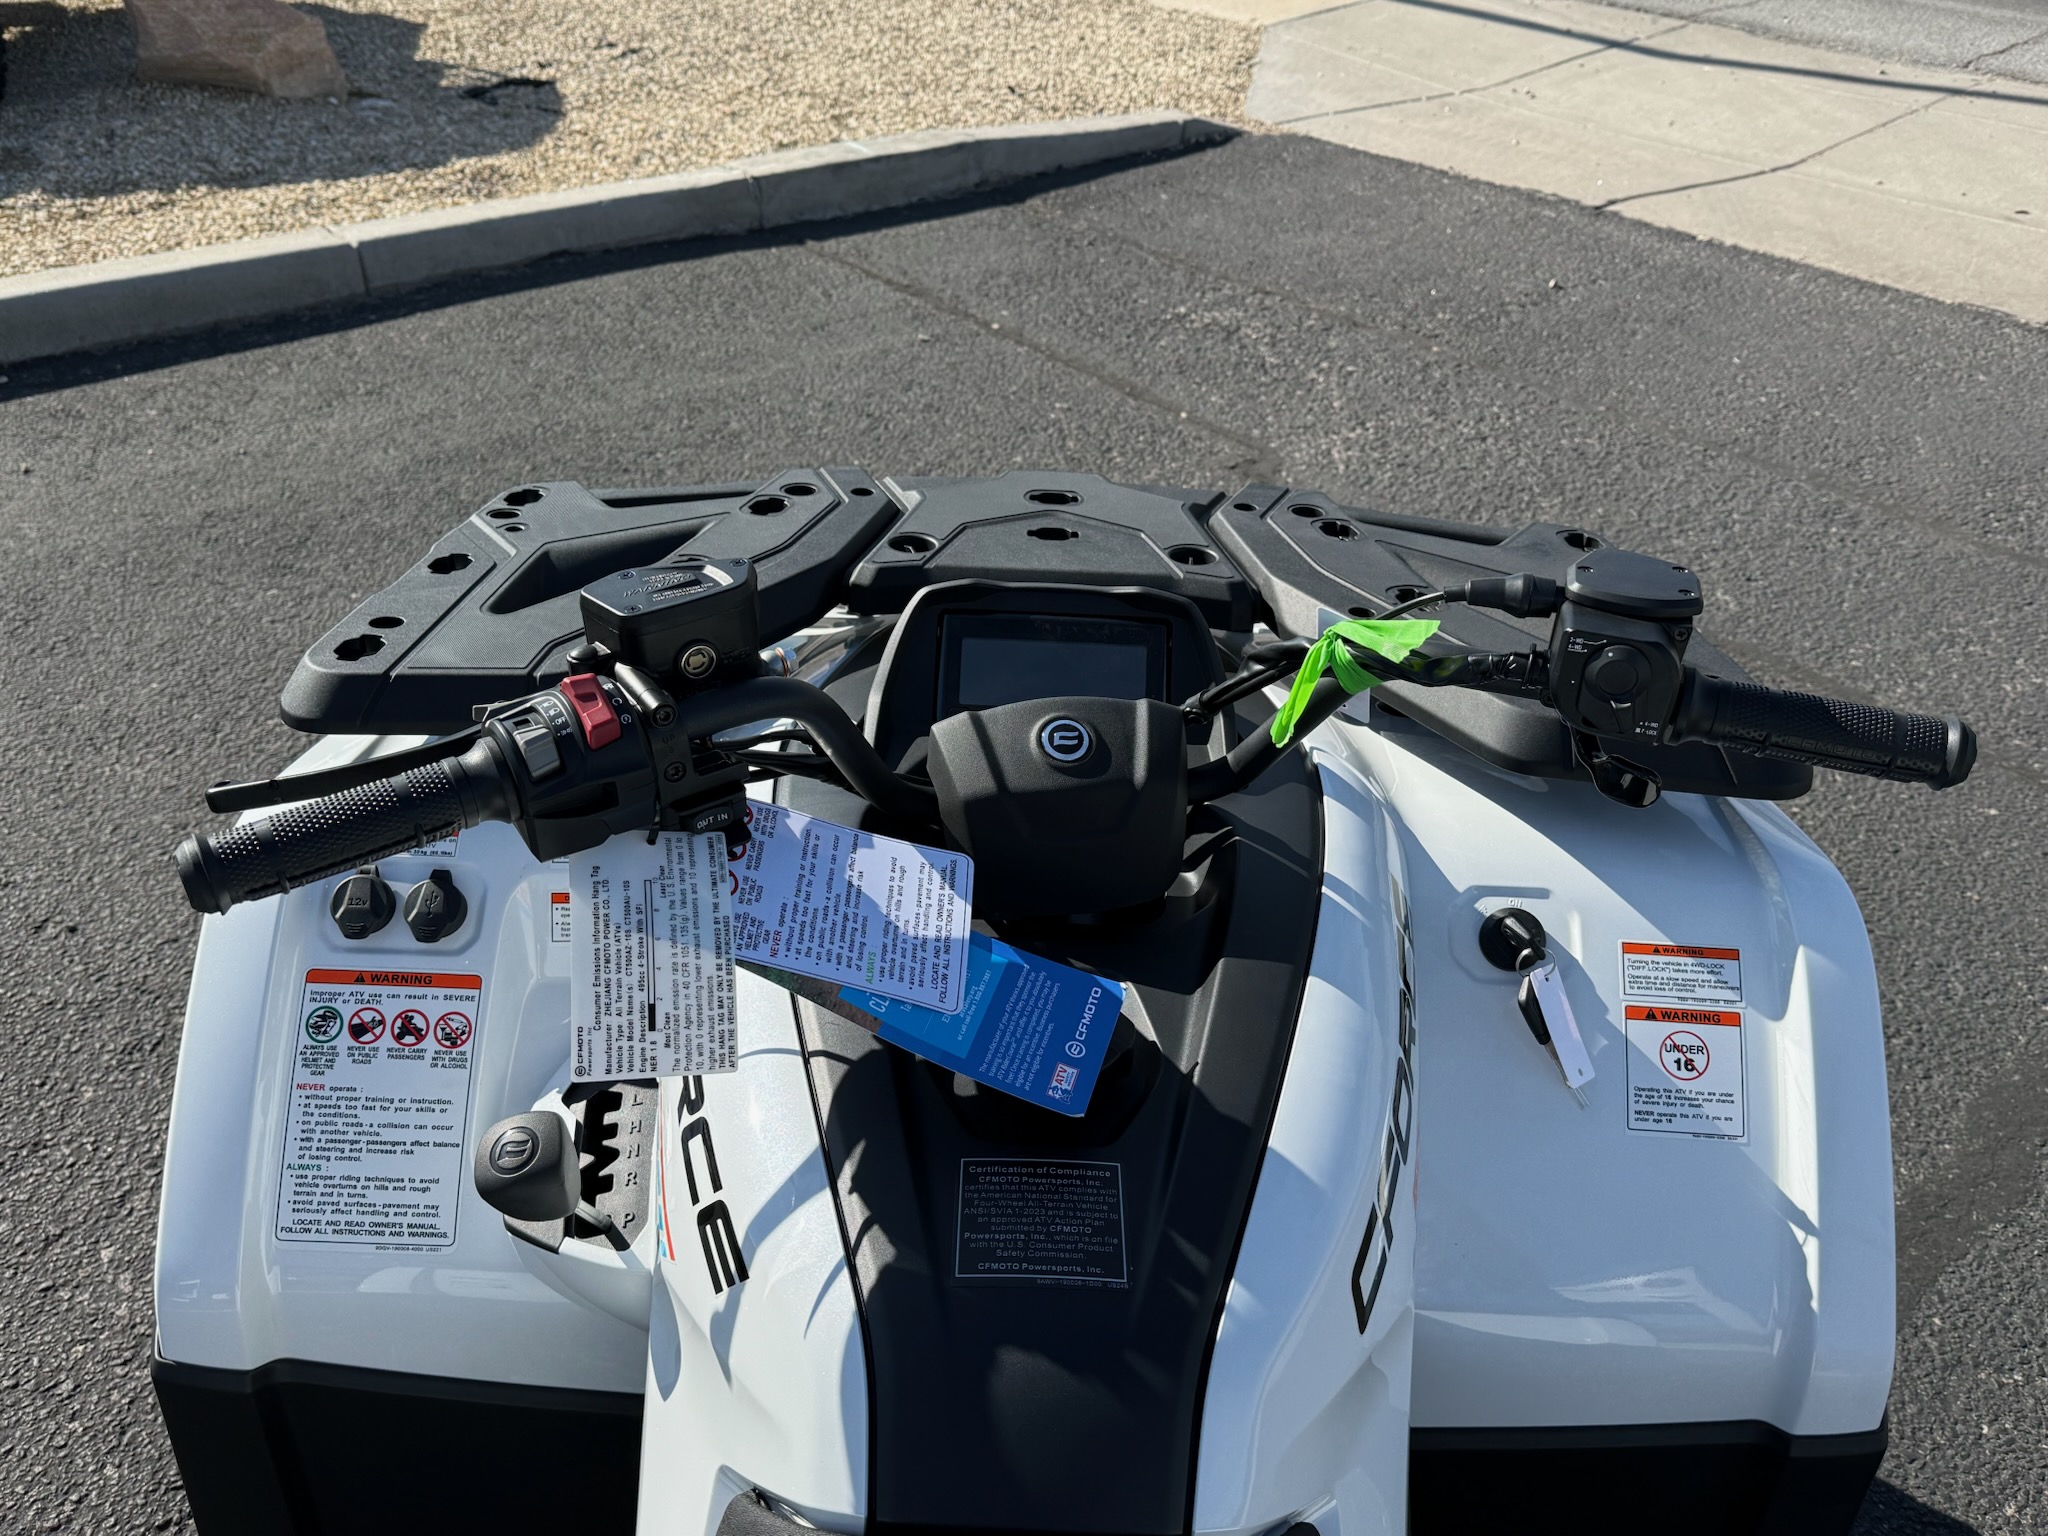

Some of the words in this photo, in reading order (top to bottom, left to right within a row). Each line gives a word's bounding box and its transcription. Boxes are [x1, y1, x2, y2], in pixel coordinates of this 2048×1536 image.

[555, 716, 566, 725] OFF
[696, 816, 714, 829] OUT
[717, 813, 728, 821] IN
[707, 836, 715, 867] CONSUMER
[591, 865, 600, 877] Tag
[938, 863, 947, 890] MANUAL.
[948, 858, 958, 891] WARNINGS.
[591, 880, 600, 898] Hang
[709, 870, 718, 898] ULTIMATE
[602, 895, 610, 909] CO.,
[635, 903, 643, 914] SFI
[935, 892, 945, 922] OWNER'S
[947, 892, 955, 907] AND
[591, 902, 600, 944] Information
[602, 912, 610, 939] POWER
[713, 916, 720, 924] BY
[613, 922, 621, 946] (ATVs)
[722, 915, 731, 954] PURCHASED
[769, 929, 783, 958] NEVER
[776, 901, 788, 927] operate
[933, 923, 942, 943] READ
[942, 908, 954, 954] INSTRUCTIONS
[636, 936, 644, 967] 4-Stroke
[713, 927, 722, 959] REMOVED
[932, 944, 941, 959] AND
[1663, 947, 1703, 955] WARNING
[603, 942, 611, 974] CFMOTO
[614, 947, 622, 974] Vehicle
[715, 962, 723, 971] BE
[724, 957, 732, 975] BEEN
[865, 950, 875, 984] ALWAYS
[941, 957, 949, 970] ALL
[592, 950, 601, 986] Emissions
[929, 960, 939, 989] LOCATE
[370, 973, 432, 985] WARNING
[637, 970, 645, 991] 495cc
[716, 974, 724, 991] ONLY
[725, 978, 733, 992] HAS
[938, 971, 948, 1003] FOLLOW
[310, 989, 345, 998] Improper
[404, 992, 427, 1000] result
[443, 994, 475, 1002] SEVERE
[603, 977, 612, 1016] ZHEJIANG
[614, 977, 622, 1002] Terrain
[309, 996, 338, 1004] INJURY
[726, 994, 734, 1024] VEHICLE
[593, 990, 602, 1030] Consumer
[717, 1012, 725, 1025] TAG
[1074, 985, 1102, 1041] CFMOTO
[1660, 1010, 1720, 1022] WARNING
[626, 1019, 634, 1041] Model
[718, 1028, 726, 1049] HANG
[576, 1025, 584, 1064] CFMOTO
[1664, 1043, 1704, 1054] UNDER
[616, 1045, 624, 1073] Vehicle
[626, 1045, 634, 1072] Vehicle
[639, 1045, 648, 1072] Engine
[728, 1044, 736, 1067] AFTER
[1673, 1057, 1695, 1071] 16
[1053, 1065, 1069, 1085] ATV
[296, 1083, 325, 1091] NEVER
[304, 1093, 332, 1101] without
[335, 1095, 361, 1103] proper
[364, 1096, 394, 1104] training
[410, 1097, 454, 1105] instruction.
[631, 1094, 643, 1107] L
[629, 1120, 642, 1134] H
[627, 1144, 640, 1159] N
[286, 1163, 322, 1171] ALWAYS
[969, 1165, 1033, 1174] Certification
[1049, 1167, 1110, 1177] Compliance
[625, 1172, 638, 1187] R
[979, 1175, 1019, 1183] CFMOTO
[292, 1218, 322, 1226] LOCATE
[368, 1221, 403, 1229] OWNER'S
[406, 1222, 440, 1230] MANUAL.
[622, 1212, 636, 1229] P
[1037, 1225, 1047, 1233] by
[1049, 1225, 1091, 1233] CFMOTO
[280, 1226, 311, 1234] FOLLOW
[331, 1228, 385, 1236] INSTRUCTIONS
[407, 1230, 449, 1239] WARNINGS.
[996, 1249, 1024, 1257] Safety
[978, 1262, 1019, 1270] CFMOTO
